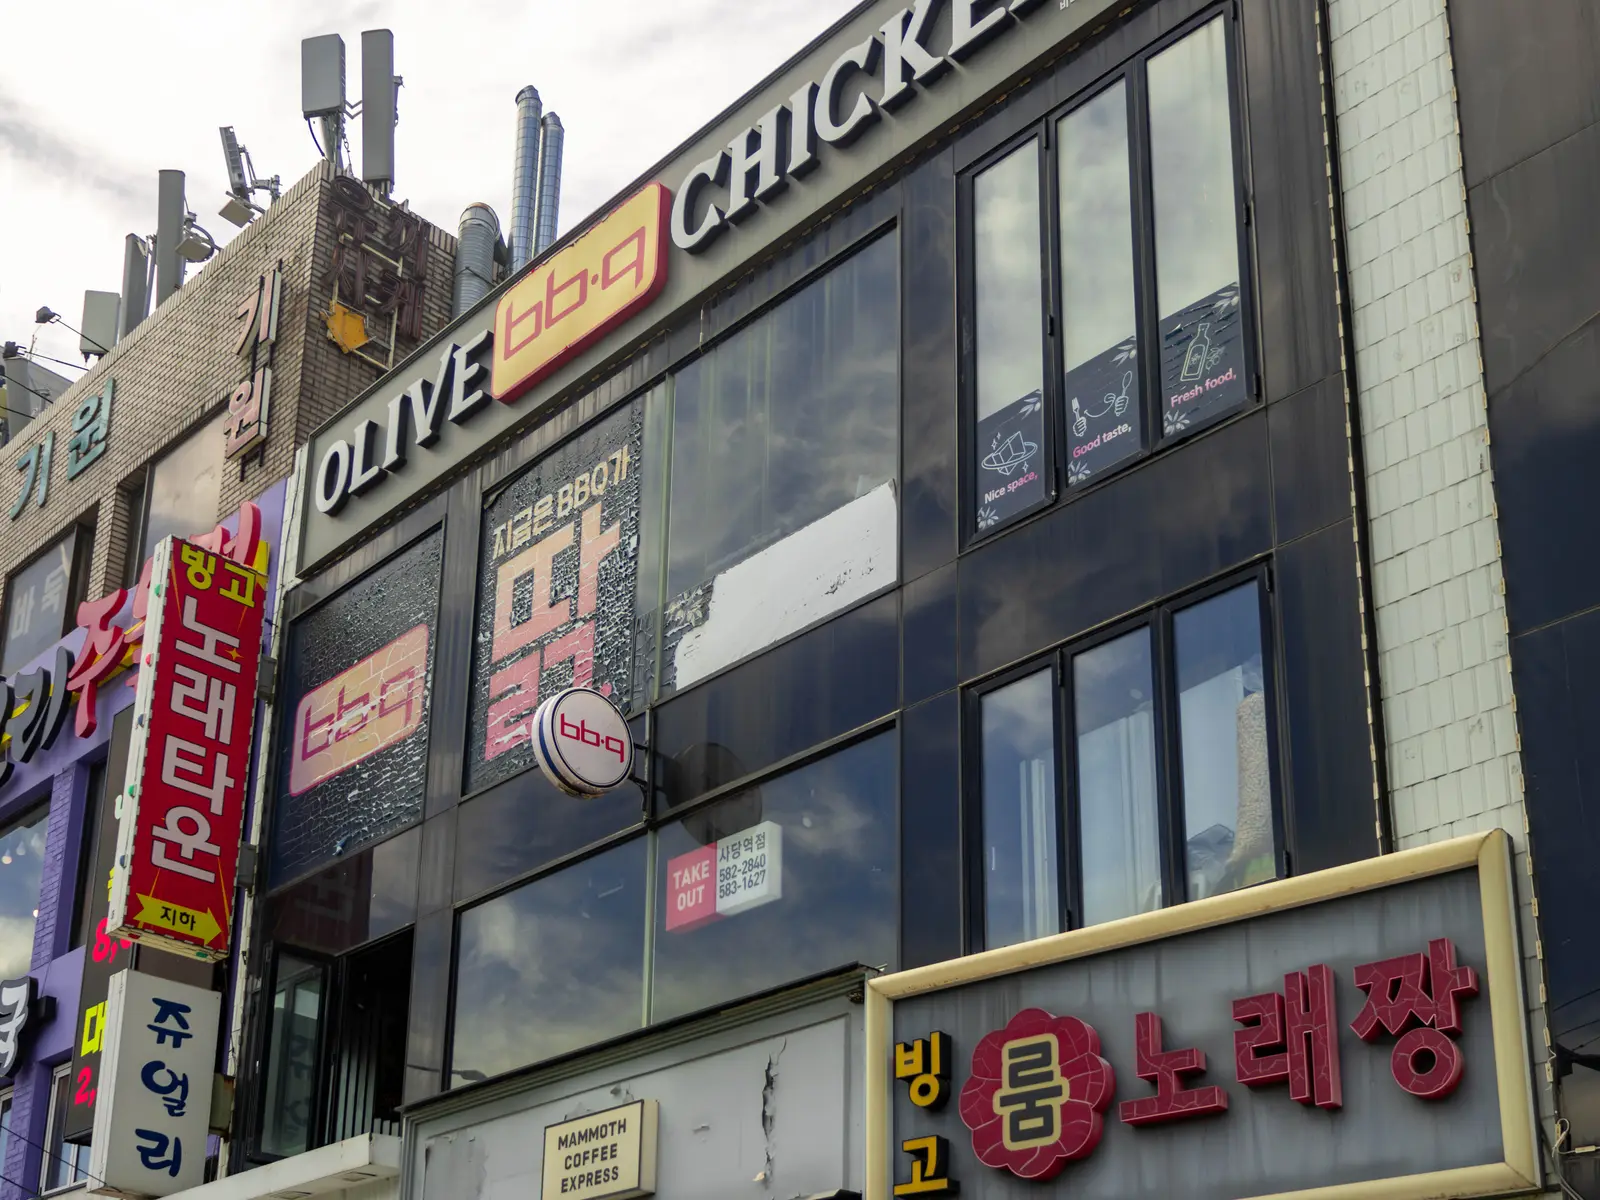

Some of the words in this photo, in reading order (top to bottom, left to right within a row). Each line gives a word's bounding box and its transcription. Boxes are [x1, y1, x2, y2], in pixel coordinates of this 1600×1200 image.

[671, 0, 1027, 250] CHICKE
[223, 265, 283, 463] 기원
[1170, 384, 1203, 408] Fresh
[1203, 368, 1237, 392] food,
[315, 330, 495, 516] OLIVE
[1072, 435, 1101, 458] Good
[1102, 422, 1132, 442] taste,
[9, 376, 117, 521] 기원
[984, 486, 1006, 504] Nice
[1006, 471, 1038, 493] space,
[181, 544, 256, 608] 빙고
[151, 595, 242, 884] 노래타운
[719, 831, 766, 863] 사당역점
[673, 860, 710, 890] TAKE
[719, 853, 766, 883] 582-2840
[719, 870, 766, 899] 583-1627
[677, 884, 705, 912] OUT
[160, 905, 196, 931] 지하
[997, 1037, 1066, 1146] 룸
[1119, 937, 1479, 1128] 노래짱
[135, 997, 194, 1178] 쥬얼리
[893, 1031, 952, 1196] 빙고
[557, 1117, 627, 1151] MAMMOTH
[563, 1142, 618, 1170] COFFEE
[560, 1165, 619, 1194] EXPRESS
